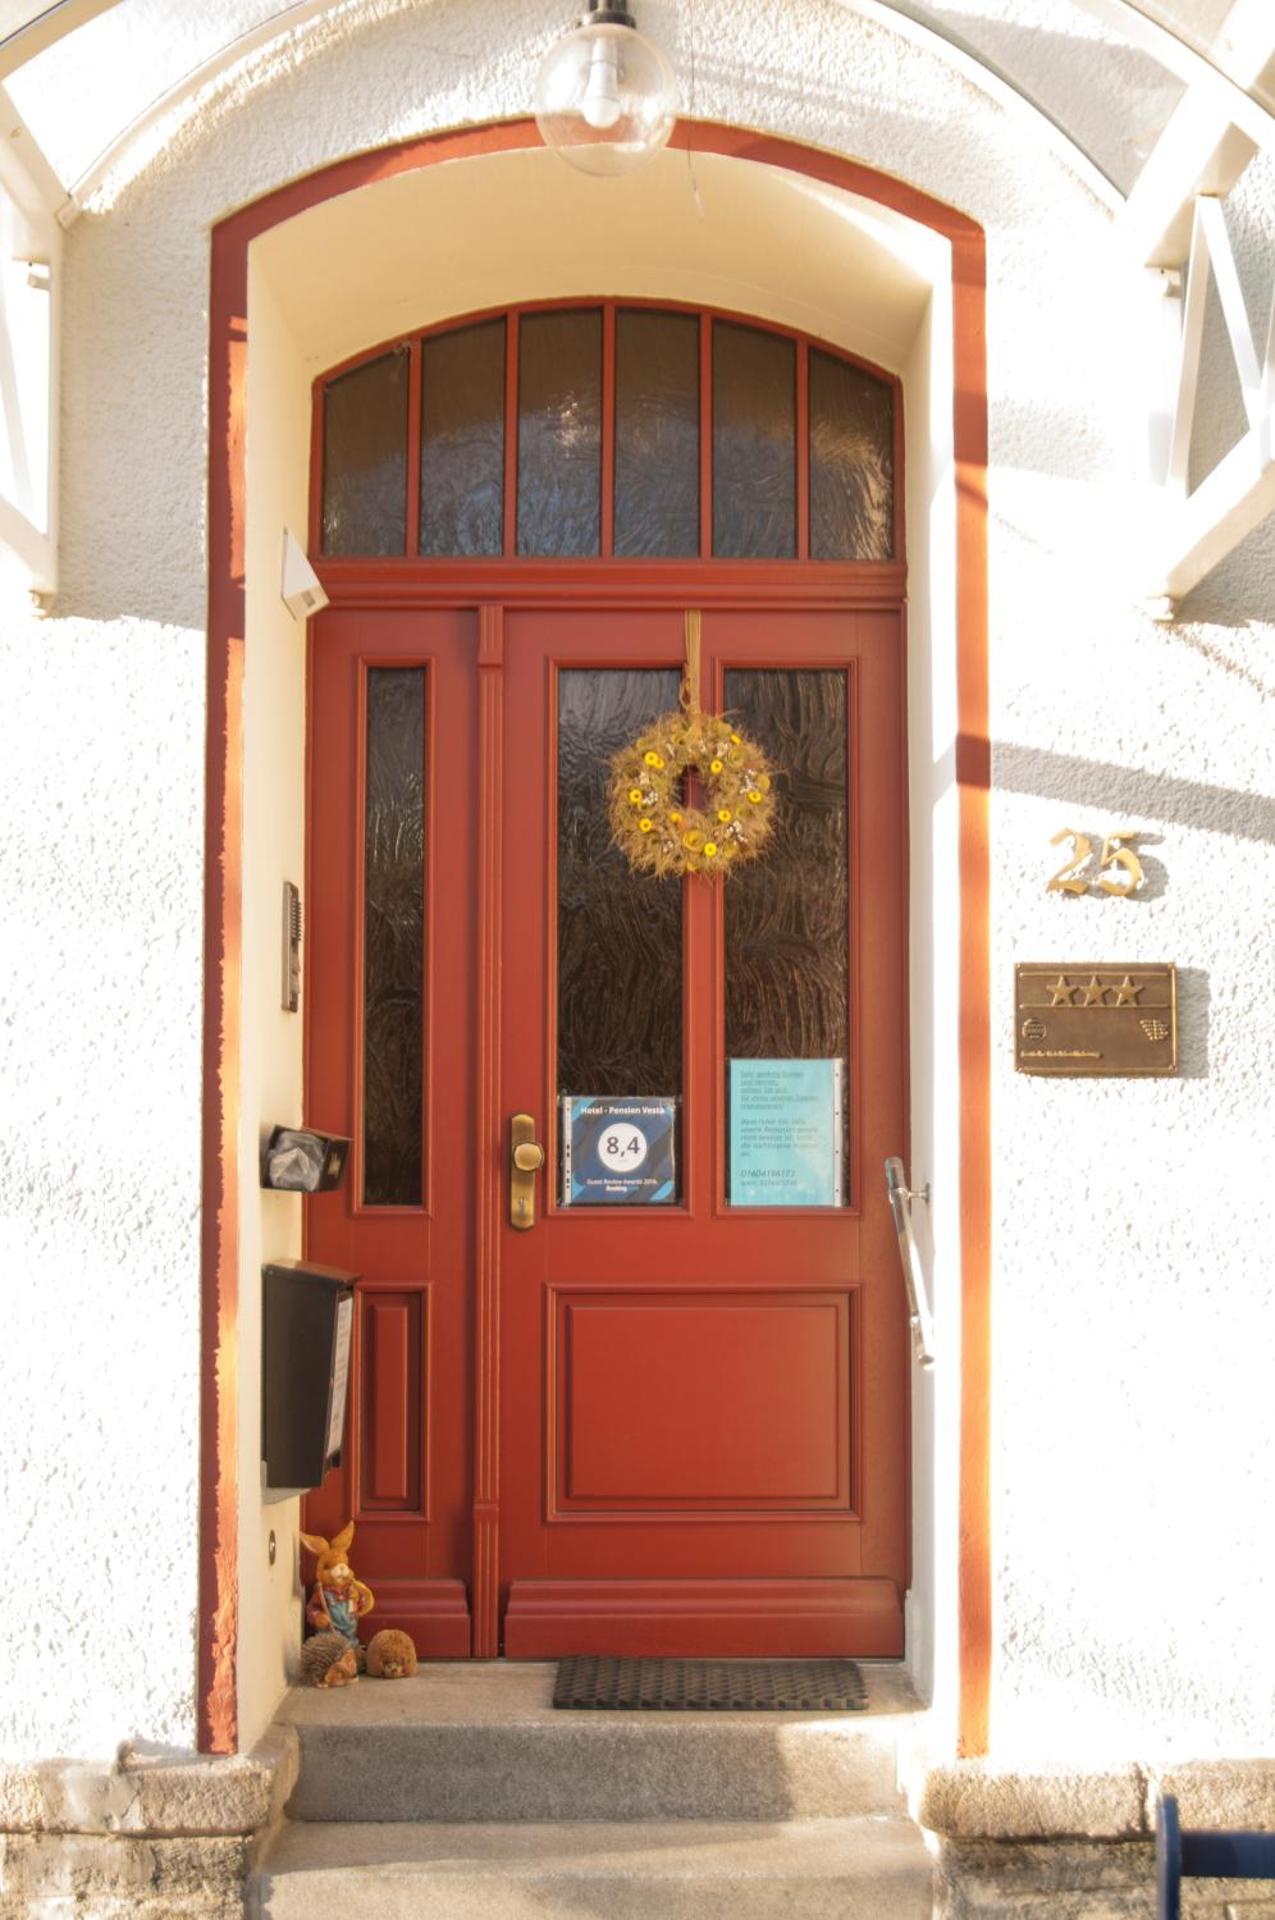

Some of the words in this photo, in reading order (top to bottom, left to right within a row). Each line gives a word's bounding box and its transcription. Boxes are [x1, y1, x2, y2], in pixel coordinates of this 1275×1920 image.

[1045, 827, 1144, 897] 25
[580, 1106, 603, 1115] Hotel
[609, 1106, 641, 1115] Pension
[642, 1106, 665, 1115] Vesta
[606, 1136, 640, 1157] 8,4
